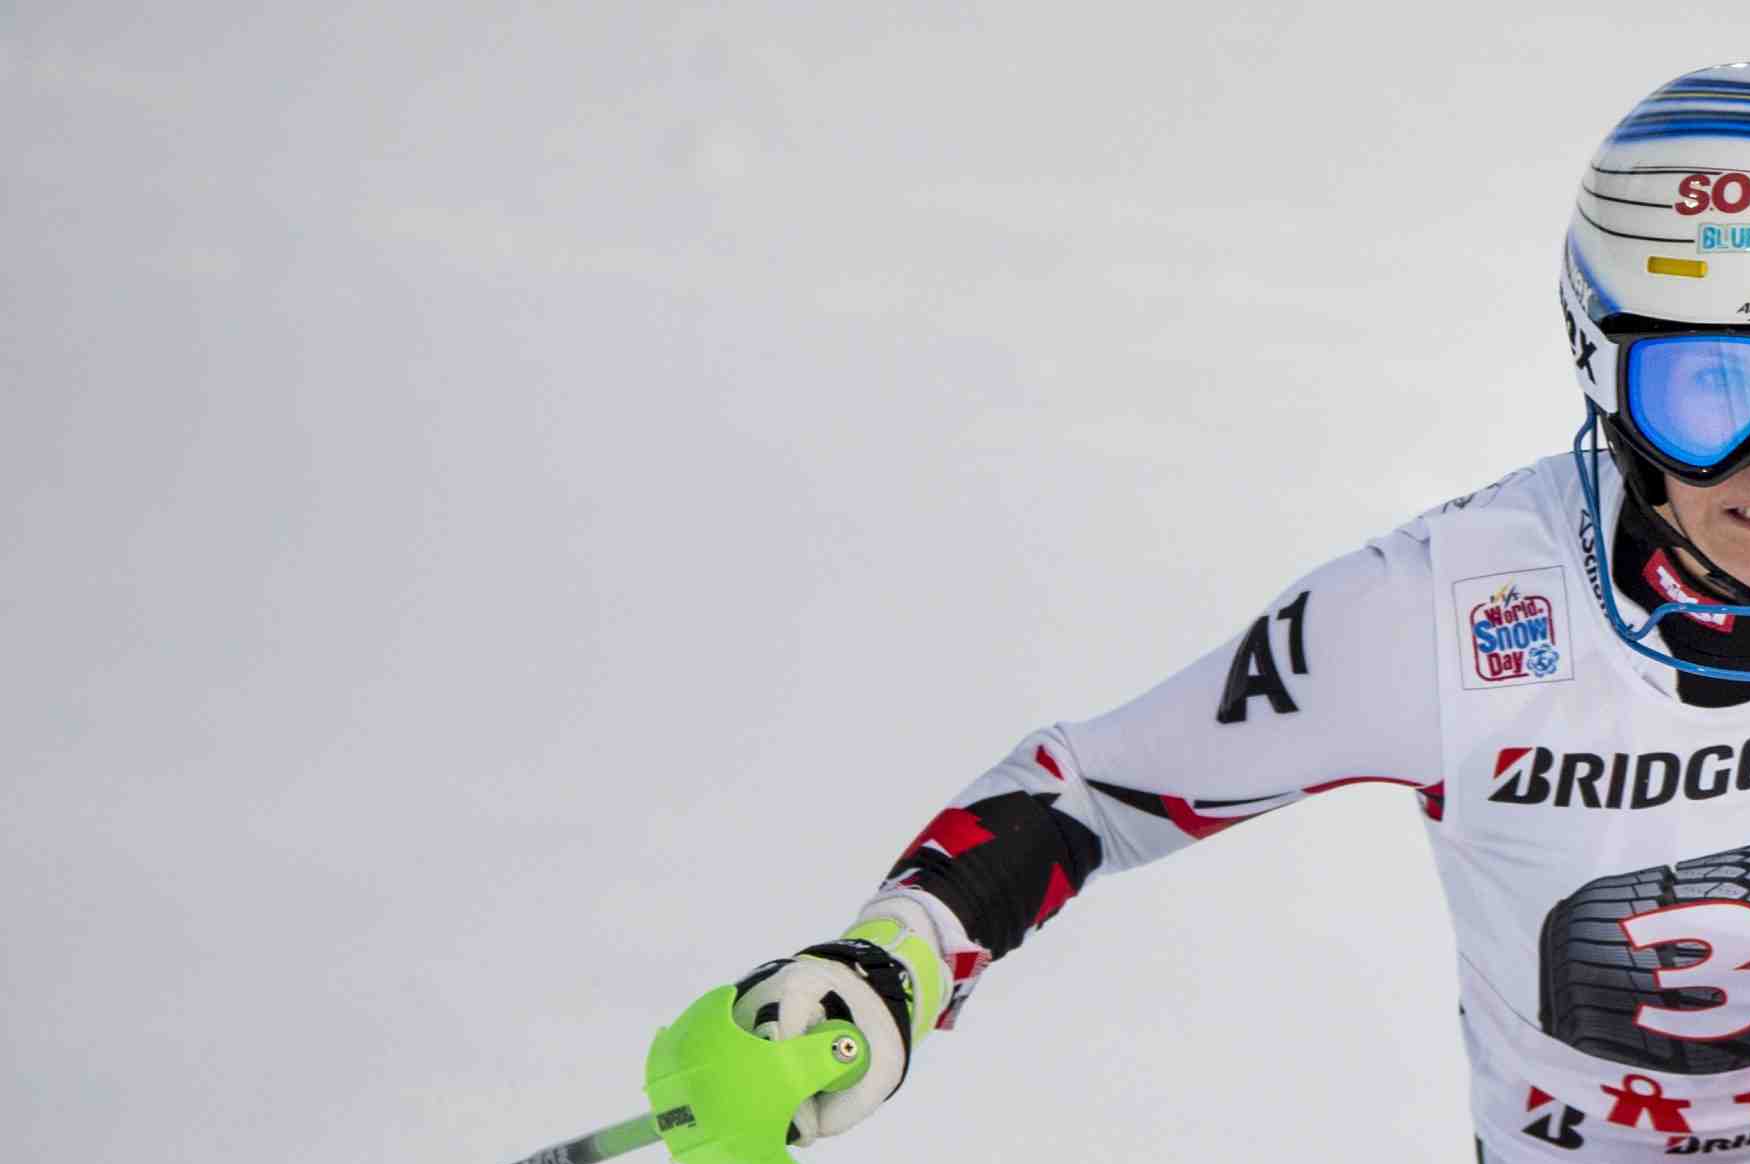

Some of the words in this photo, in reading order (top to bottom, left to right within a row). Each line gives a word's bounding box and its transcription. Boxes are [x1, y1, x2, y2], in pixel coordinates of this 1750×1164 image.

[1484, 599, 1540, 627] World
[1473, 616, 1548, 653] Snow
[1215, 589, 1313, 725] A1
[1486, 651, 1524, 677] Day
